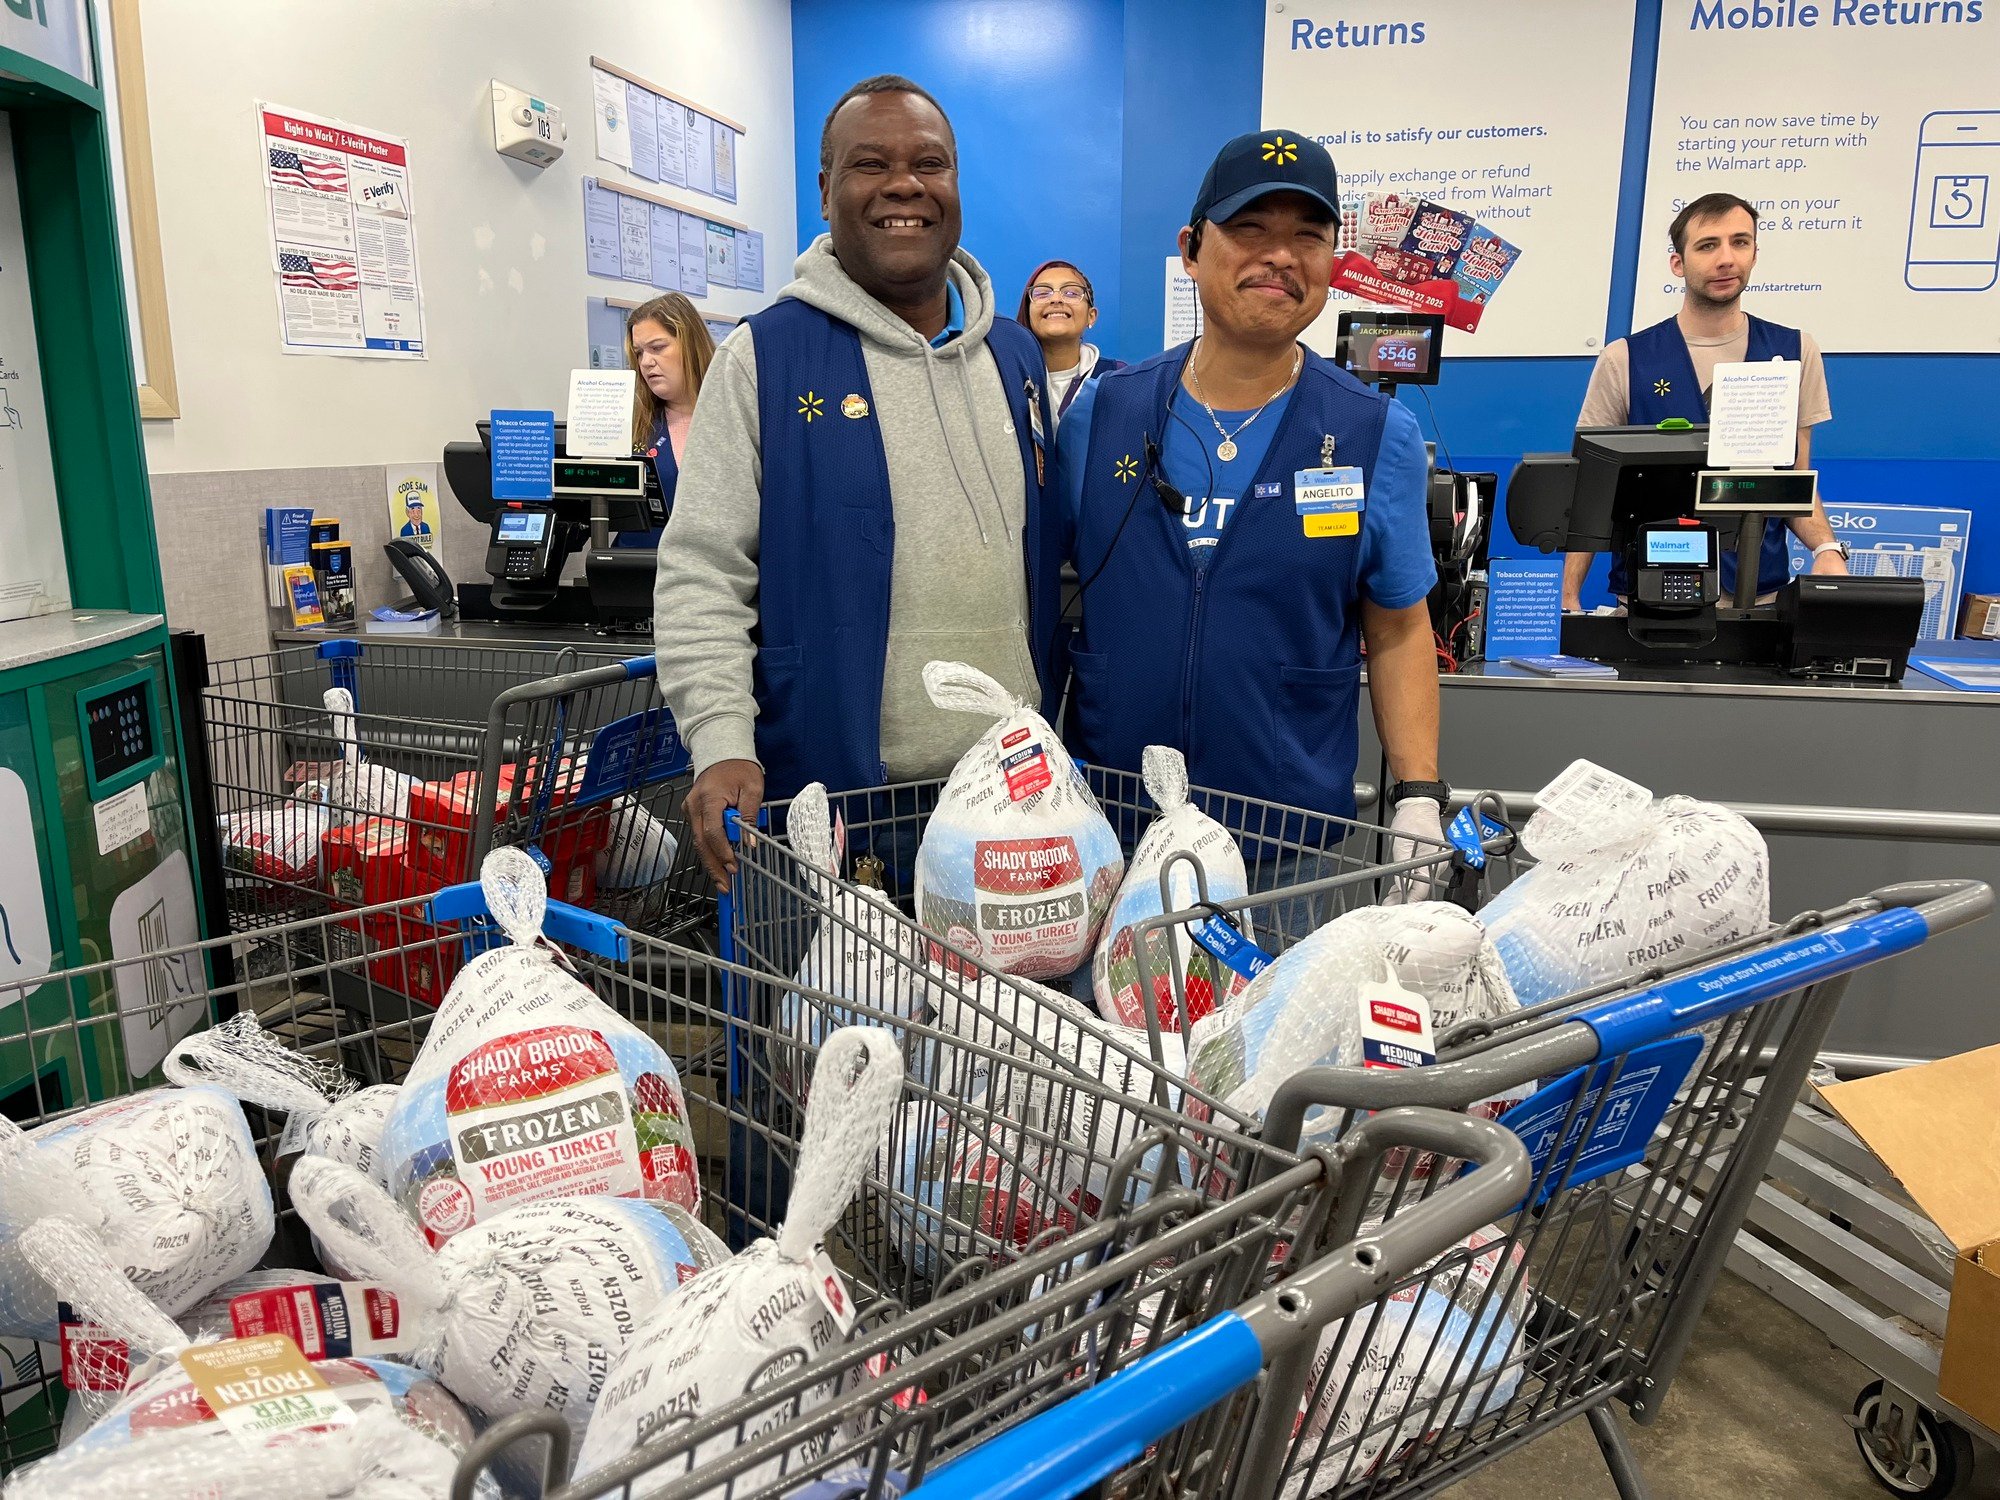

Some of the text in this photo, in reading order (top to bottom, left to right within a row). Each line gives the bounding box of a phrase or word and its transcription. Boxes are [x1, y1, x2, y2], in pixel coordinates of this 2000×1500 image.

[1689, 0, 1983, 30] Mobile Returns
[1290, 18, 1426, 50] Returns
[537, 117, 551, 140] 103
[1679, 111, 1880, 130] You can now save time by
[284, 120, 304, 137] Right
[305, 127, 313, 139] to
[314, 129, 334, 144] Work
[341, 134, 368, 154] E-Verify
[368, 143, 389, 157] Poster
[1316, 125, 1548, 148] goal is to satisfy our customers.
[1677, 133, 1867, 153] starting your return with
[308, 149, 322, 159] RIGHT
[328, 153, 342, 162] WORK
[1675, 156, 1807, 172] the Walmart app.
[1336, 164, 1531, 187] happily exchange or refund
[370, 181, 394, 198] Verify
[1451, 184, 1553, 201] from Walmart
[1476, 205, 1532, 220] without
[1780, 198, 1841, 213] on your
[1368, 213, 1411, 227] Holiday
[1374, 224, 1401, 234] Cash
[1781, 215, 1863, 230] & return it
[1413, 226, 1462, 251] Holiday
[1417, 238, 1450, 255] Cash
[1460, 249, 1504, 281] Holiday
[1462, 264, 1492, 283] Cash
[1342, 268, 1444, 309] AVAILABLE OCTOBER 27, 2025
[1359, 327, 1418, 337] JACKPOT ALERT!
[1377, 345, 1417, 361] $546
[1393, 360, 1416, 369] Million
[1722, 374, 1789, 383] Alcohol Consumer:
[495, 419, 550, 428] Tobacco Consumer:
[398, 480, 428, 494] CODE SAM
[1313, 476, 1341, 484] Walmart
[1302, 486, 1354, 500] ANGELITO
[1650, 541, 1690, 549] Walmart
[1523, 571, 1559, 579] Consumer:
[1009, 747, 1034, 764] MEDIUM
[965, 785, 994, 810] FROZEN
[1192, 830, 1221, 854] FROZEN
[983, 844, 1073, 871] SHADY BROOK
[1009, 869, 1051, 883] FARMS
[1696, 861, 1742, 910] FROZEN
[996, 900, 1070, 928] FROZEN
[1703, 909, 1736, 936] FROZEN
[991, 931, 1033, 945] YOUNG
[1035, 921, 1079, 939] TURKEY
[1207, 918, 1238, 946] Always
[1627, 933, 1687, 967] FROZEN
[1697, 979, 1724, 993] Shop
[1722, 973, 1738, 985] the
[1734, 966, 1757, 980] store
[1754, 962, 1765, 974] &
[1762, 956, 1785, 970] more
[1783, 950, 1801, 963] with
[483, 973, 507, 996] FROZEN
[441, 990, 464, 1019] FROZEN
[475, 989, 514, 1029] FROZEN
[516, 993, 554, 1016] FROZEN
[1373, 1003, 1419, 1024] SHADY BROOK
[432, 1003, 476, 1053] FROZEN
[1386, 1017, 1408, 1028] FARMS
[459, 1031, 600, 1087] SHADY BROOK
[1380, 1043, 1424, 1064] MEDIUM
[497, 1062, 563, 1089] FARMS
[482, 1100, 600, 1152] FROZEN
[479, 1128, 618, 1183] YOUNG TURKEY
[654, 1157, 677, 1177] USA
[485, 1192, 506, 1204] TURKEY
[506, 1186, 526, 1198] BROTH,
[526, 1181, 542, 1191] SALT,
[542, 1175, 561, 1186] SUGAR
[561, 1171, 572, 1180] AND
[573, 1164, 596, 1178] NATURAL
[521, 1189, 555, 1203] TURKEYS
[557, 1181, 584, 1192] RAISED
[578, 1182, 610, 1197] FARMS
[424, 1189, 463, 1221] SIMPLY THAW
[440, 1203, 460, 1219] COOK
[153, 1231, 191, 1251] FROZEN
[598, 1236, 644, 1284] FROZEN
[568, 1278, 594, 1318] FROZEN
[300, 1301, 315, 1341] SERVES 7-11
[321, 1302, 333, 1336] GATHERINGS
[326, 1296, 348, 1341] MEDIUM
[749, 1278, 808, 1342] FROZEN
[666, 1343, 702, 1375] FROZEN
[214, 1368, 317, 1405] FROZEN
[512, 1357, 537, 1401] FROZEN
[250, 1394, 316, 1419] EVER
[636, 1382, 702, 1444] FROZEN
